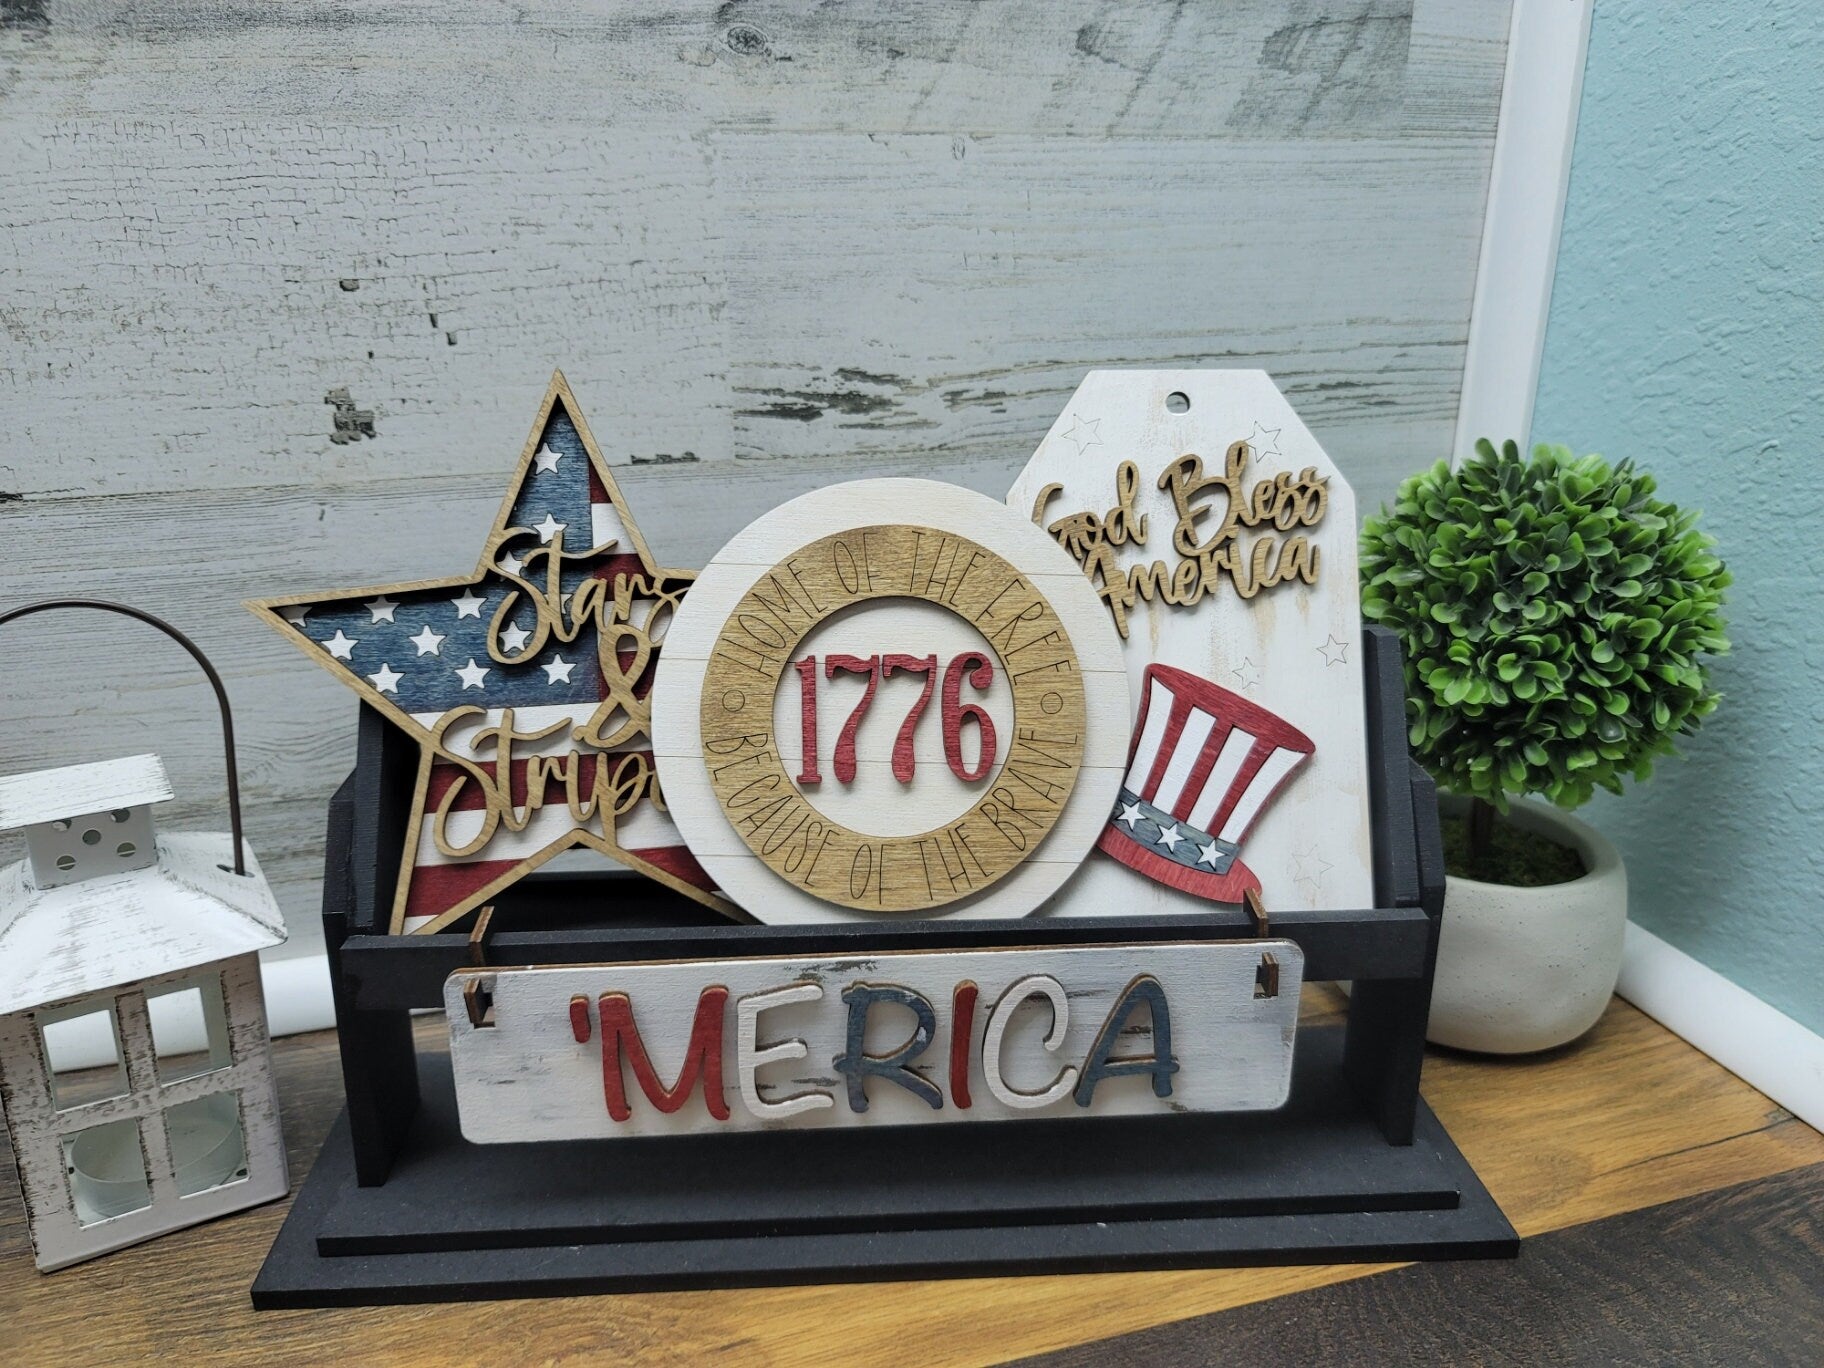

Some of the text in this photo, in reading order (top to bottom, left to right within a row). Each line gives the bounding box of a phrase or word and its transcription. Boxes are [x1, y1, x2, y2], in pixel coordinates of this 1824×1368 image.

[1157, 440, 1330, 557] Bless
[487, 527, 691, 665] Stars
[717, 530, 1073, 686] HOME OF THE FREE
[1082, 536, 1321, 640] America
[572, 624, 653, 748] &
[795, 651, 997, 785] 1776
[705, 727, 1079, 905] BECAUSE OF THE BRAVE
[569, 972, 1181, 1122] 'MERICA
